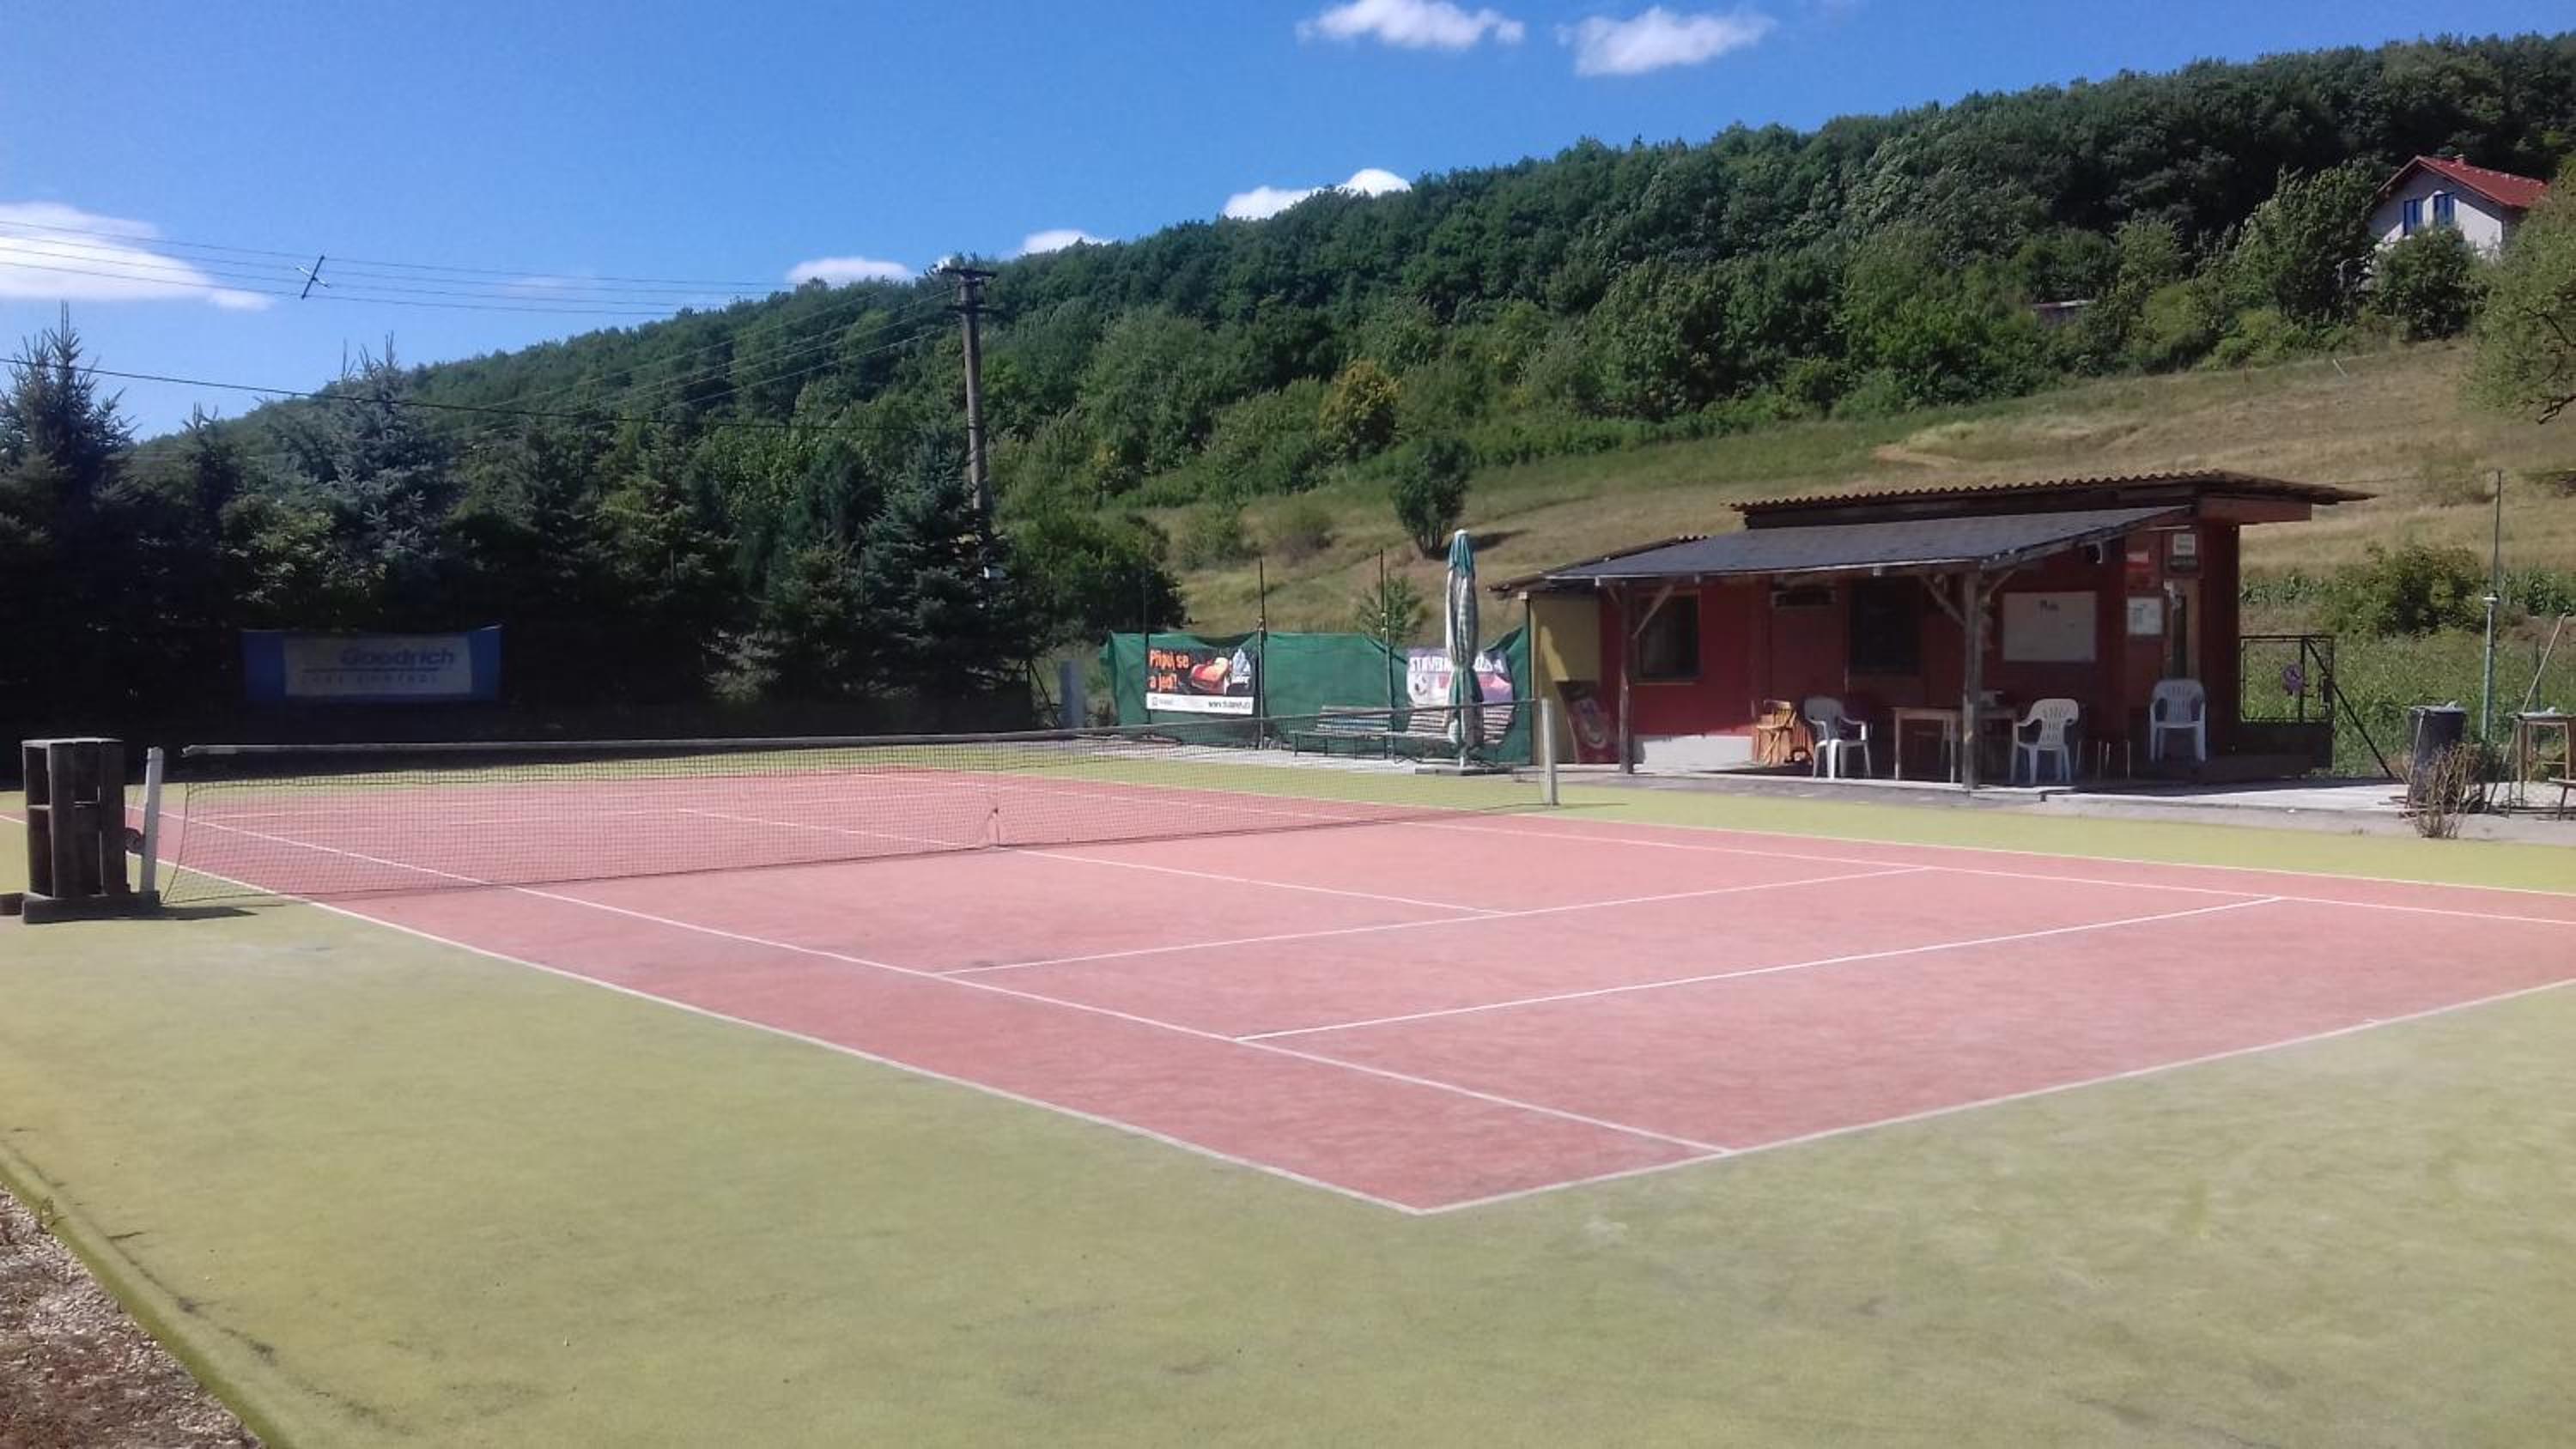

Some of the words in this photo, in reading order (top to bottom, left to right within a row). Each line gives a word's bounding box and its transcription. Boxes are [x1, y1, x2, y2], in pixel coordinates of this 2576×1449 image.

[340, 646, 455, 666] Goodrich
[1176, 654, 1190, 670] se
[1148, 675, 1157, 689] a
